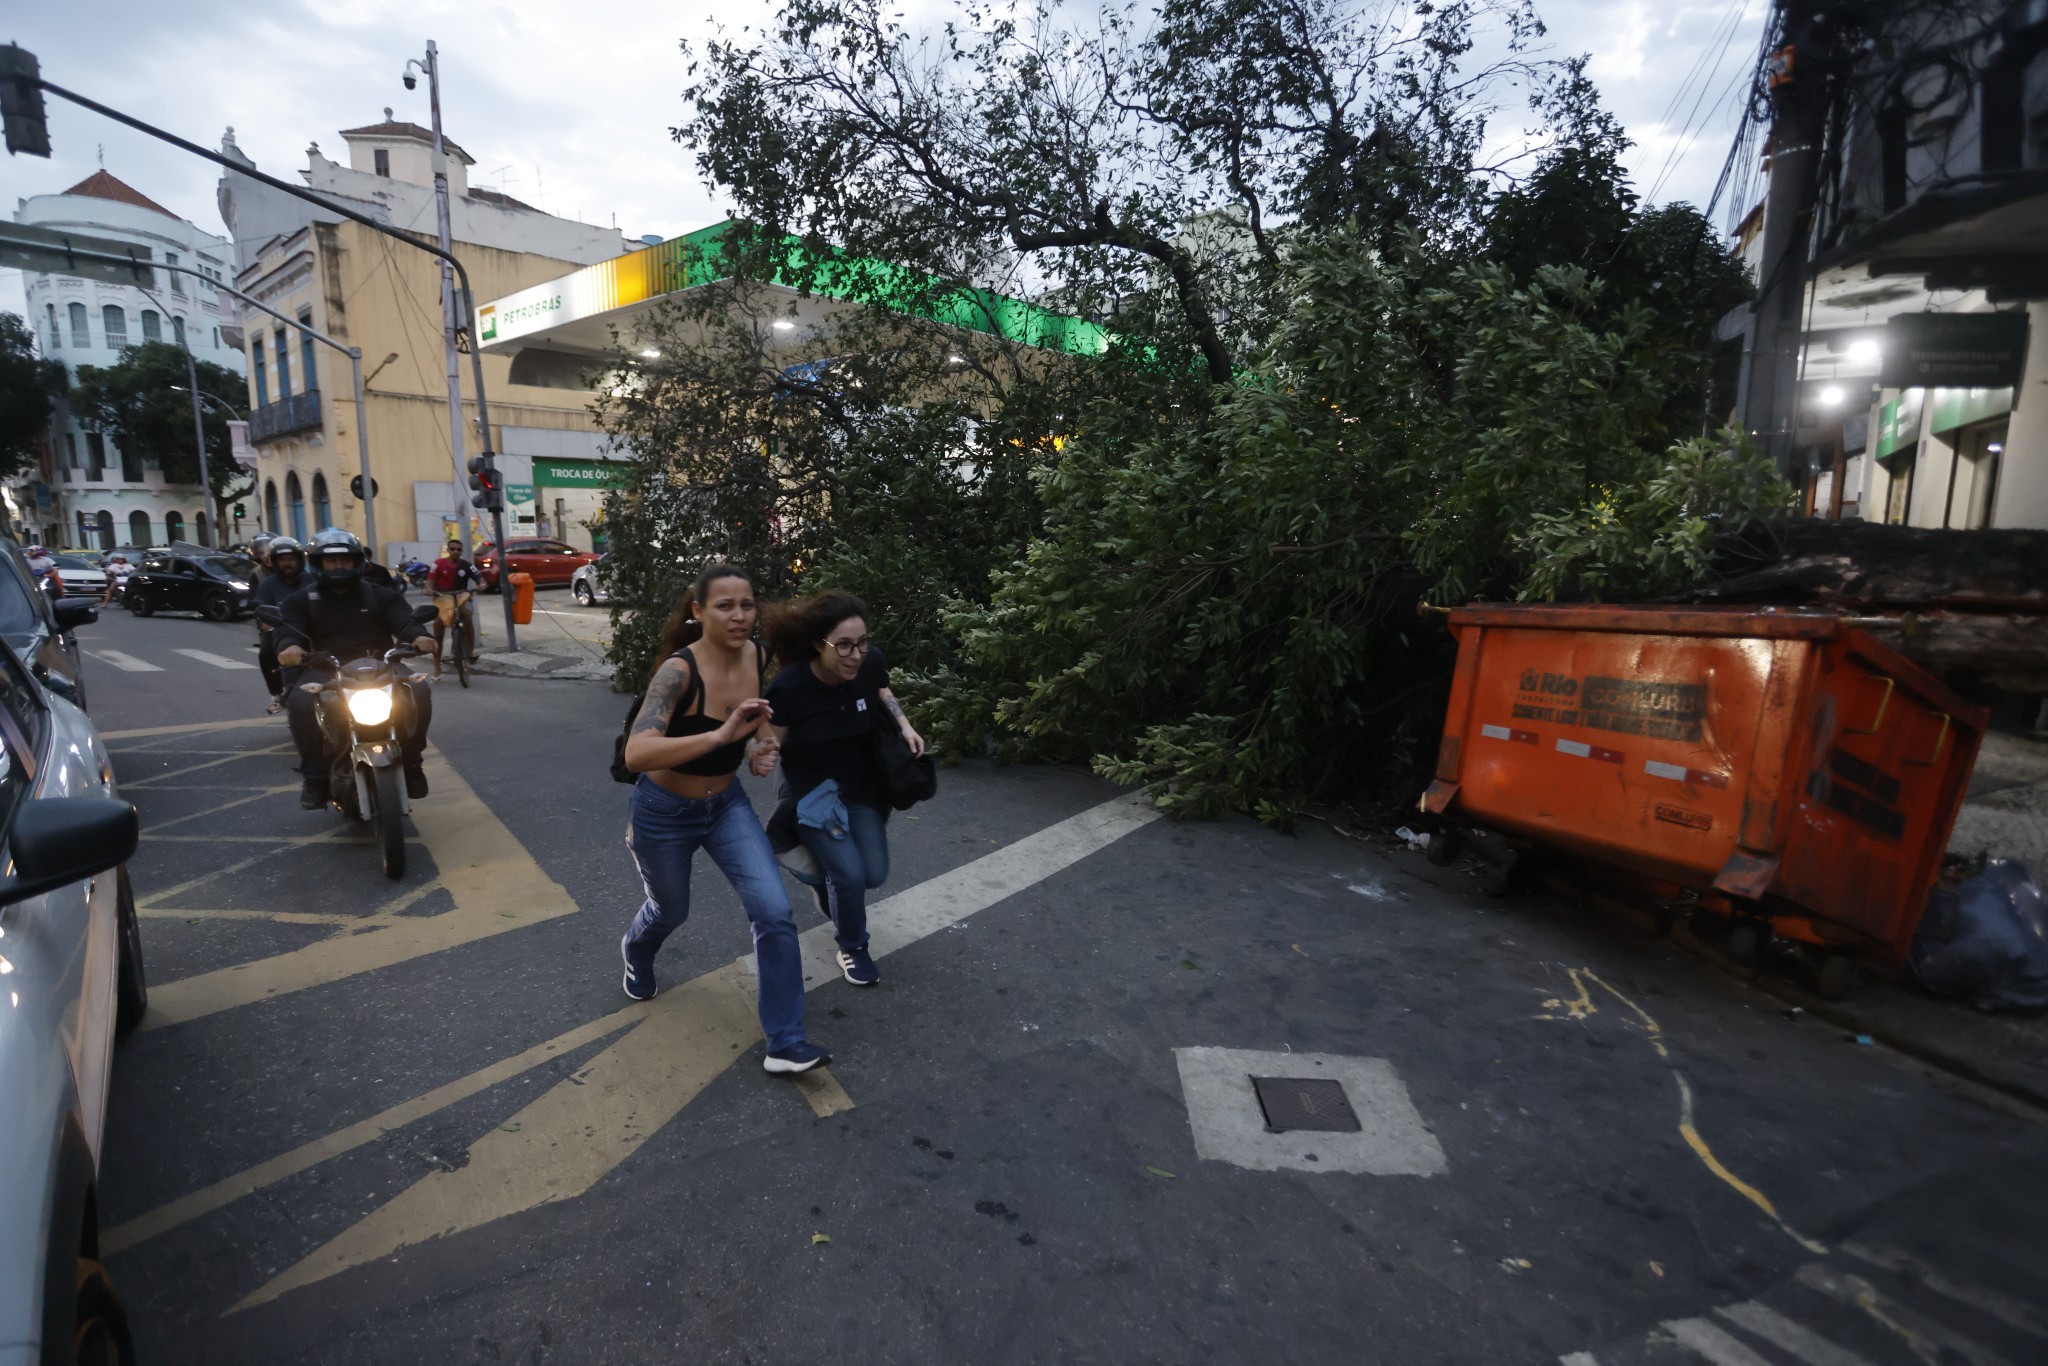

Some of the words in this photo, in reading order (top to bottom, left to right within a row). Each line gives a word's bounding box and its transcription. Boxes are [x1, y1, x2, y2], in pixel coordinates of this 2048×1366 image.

[504, 295, 561, 325] PETROBRAS
[550, 468, 581, 478] TROCA
[582, 470, 594, 479] DE
[1540, 672, 1577, 696] Rio
